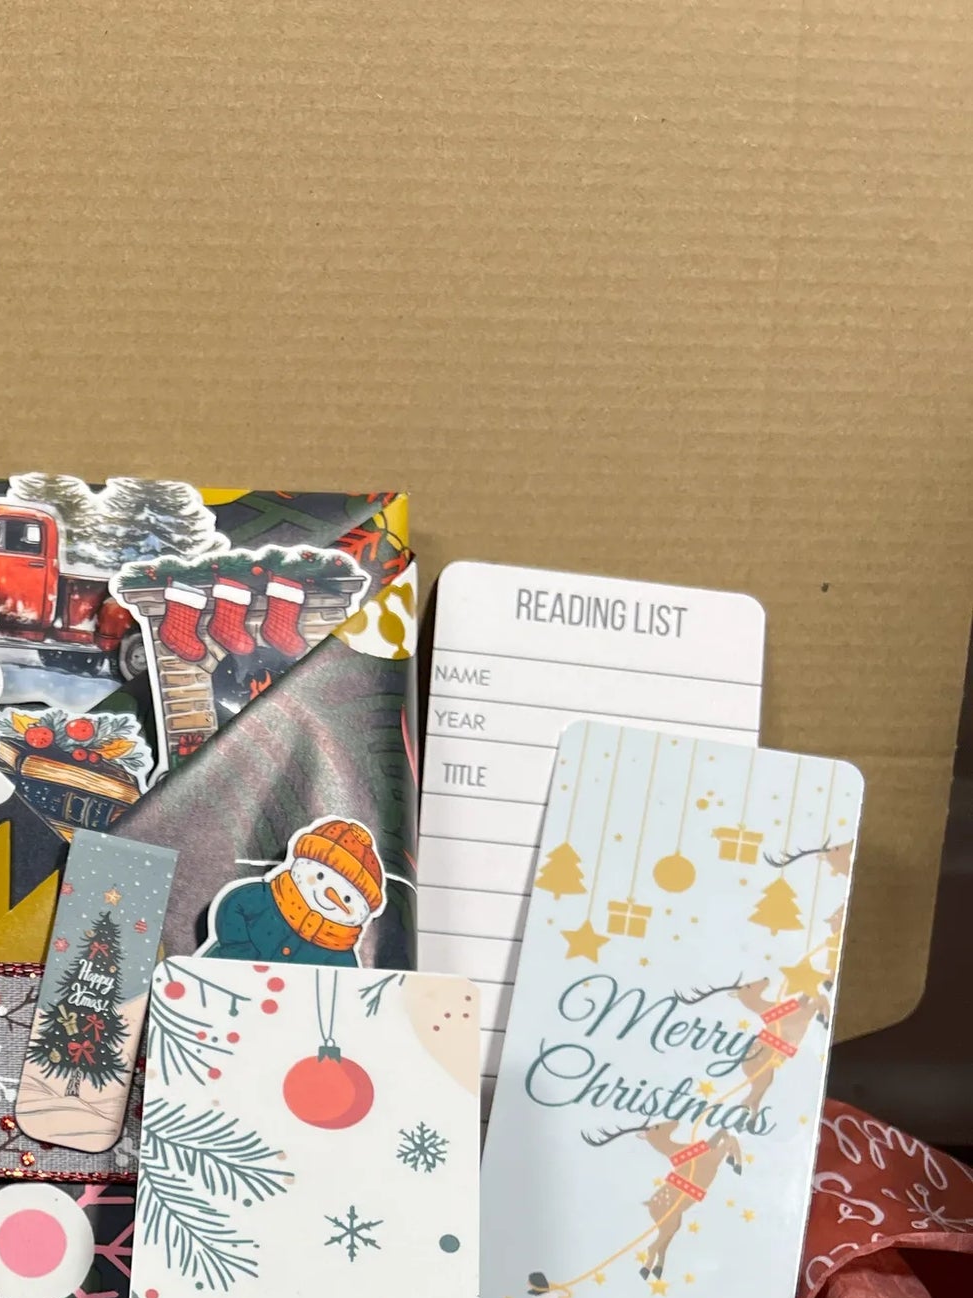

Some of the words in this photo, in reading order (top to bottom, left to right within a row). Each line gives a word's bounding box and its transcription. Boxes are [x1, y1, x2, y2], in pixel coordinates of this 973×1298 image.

[515, 588, 627, 632] READING
[633, 601, 689, 638] LIST
[434, 664, 491, 687] NAME
[434, 710, 487, 731] YEAR
[442, 762, 488, 788] TITLE
[78, 959, 115, 995] Happy
[558, 974, 764, 1078] Merry
[525, 1038, 777, 1136] Christmas
